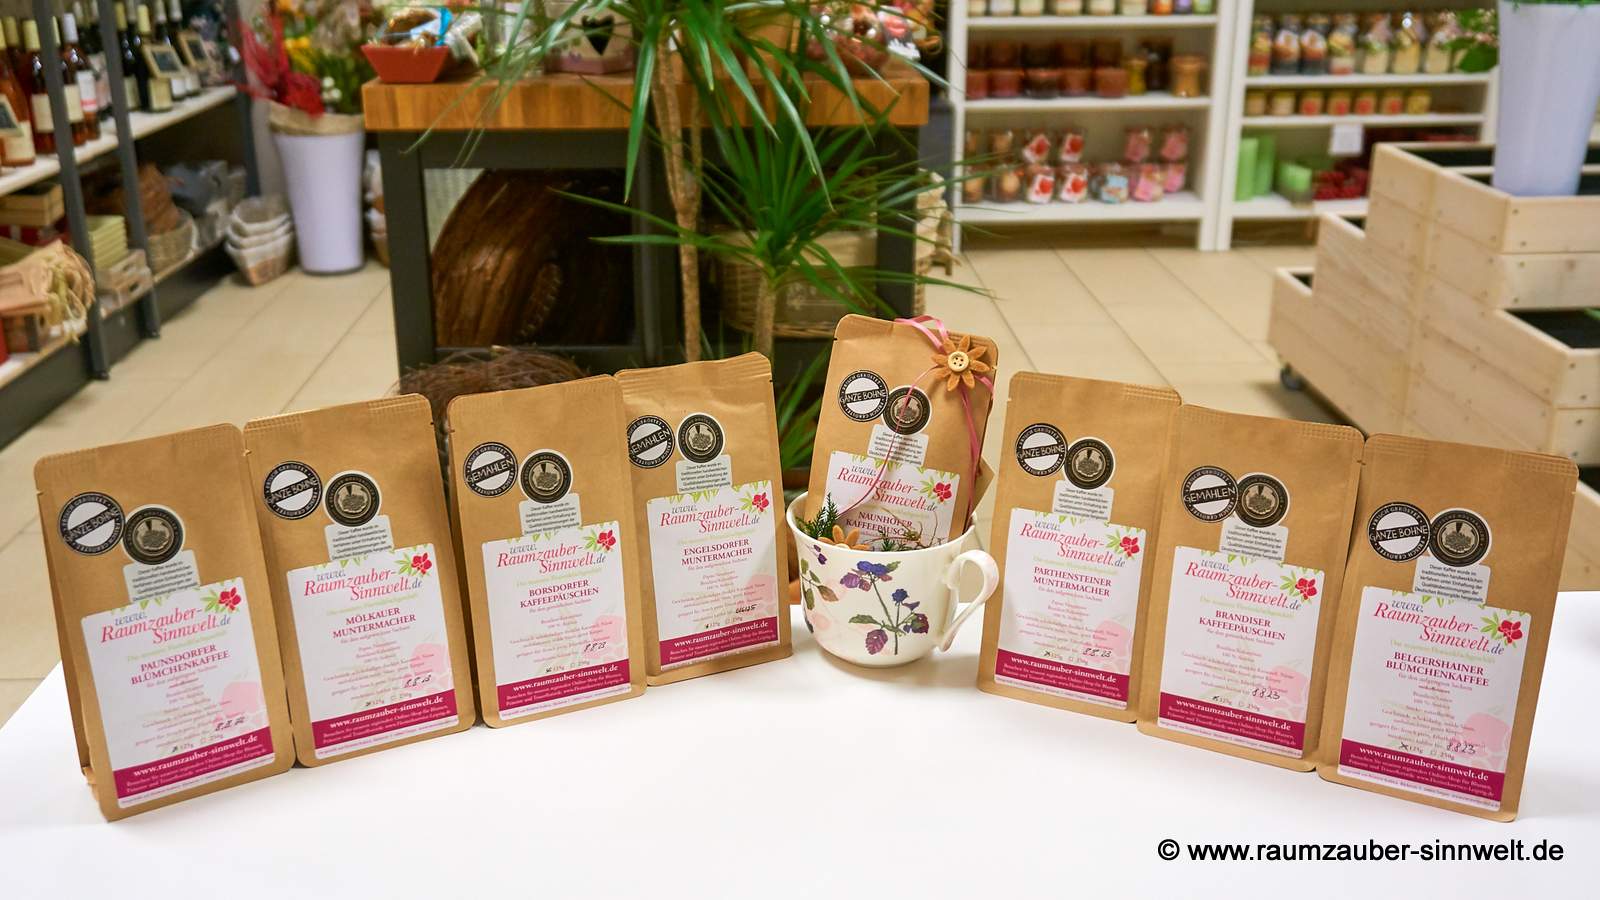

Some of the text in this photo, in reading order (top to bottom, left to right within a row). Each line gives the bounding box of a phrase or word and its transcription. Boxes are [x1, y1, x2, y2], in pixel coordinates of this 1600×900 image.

[840, 389, 888, 404] GANZE BOHNE
[1017, 445, 1064, 458] GANZE BOHNE
[466, 459, 513, 483] GEMAHLEN
[871, 488, 937, 512] Sinnwelt.de
[1184, 487, 1235, 503] GEMAHLEN
[660, 503, 739, 527] Raumzauber-
[699, 513, 759, 533] Sinnwelt.de
[1020, 523, 1104, 548] Raumzauber-
[1370, 526, 1428, 541] GANZE BOHNE
[497, 543, 583, 567] Raumzauber-
[681, 545, 752, 566] MUNTERMACHER
[684, 537, 748, 556] ENGELSDORFER
[1057, 544, 1125, 567] Sinnwelt.de
[539, 551, 605, 573] Sinnwelt.de
[304, 567, 395, 595] Raumzauber-
[529, 578, 588, 596] BORSDORFER
[1033, 566, 1112, 586] PARTHENSTEINER
[1033, 575, 1109, 596] MUNTERMACHER
[1185, 562, 1278, 590] Raumzauber-
[350, 577, 422, 600] Sinnwelt.de
[1226, 584, 1301, 610] Sinnwelt.de
[101, 607, 202, 642] Raumzauber-
[152, 614, 230, 644] Sinnwelt.de
[332, 613, 416, 638] MUNTERMACHER
[1199, 616, 1285, 640] KAFFEEPÄUSCHEN
[1215, 610, 1271, 627] BRANDISER
[1373, 602, 1478, 633] Raumzauber-
[674, 621, 768, 646] www.raumzauber-sinnwelt.de
[1419, 626, 1504, 655] Sinnwelt.de
[140, 643, 217, 671] PAUNSDORFER
[1394, 651, 1484, 675] BELGERSHAINER
[513, 664, 618, 691] www.raumzauber-sinnwelt.de
[1011, 657, 1116, 683] www.raumzauber-sinnwelt.de
[1385, 659, 1489, 686] BLÜMCHENKAFFEE
[330, 696, 443, 728] www.raumzauber-sinnwelt.de
[1176, 701, 1290, 731] www.raumzauber-sinnwelt.de
[133, 735, 258, 776] www.raumzauber-sinnwelt.de
[1359, 747, 1488, 781] www.raumzauber-sinnwelt.de
